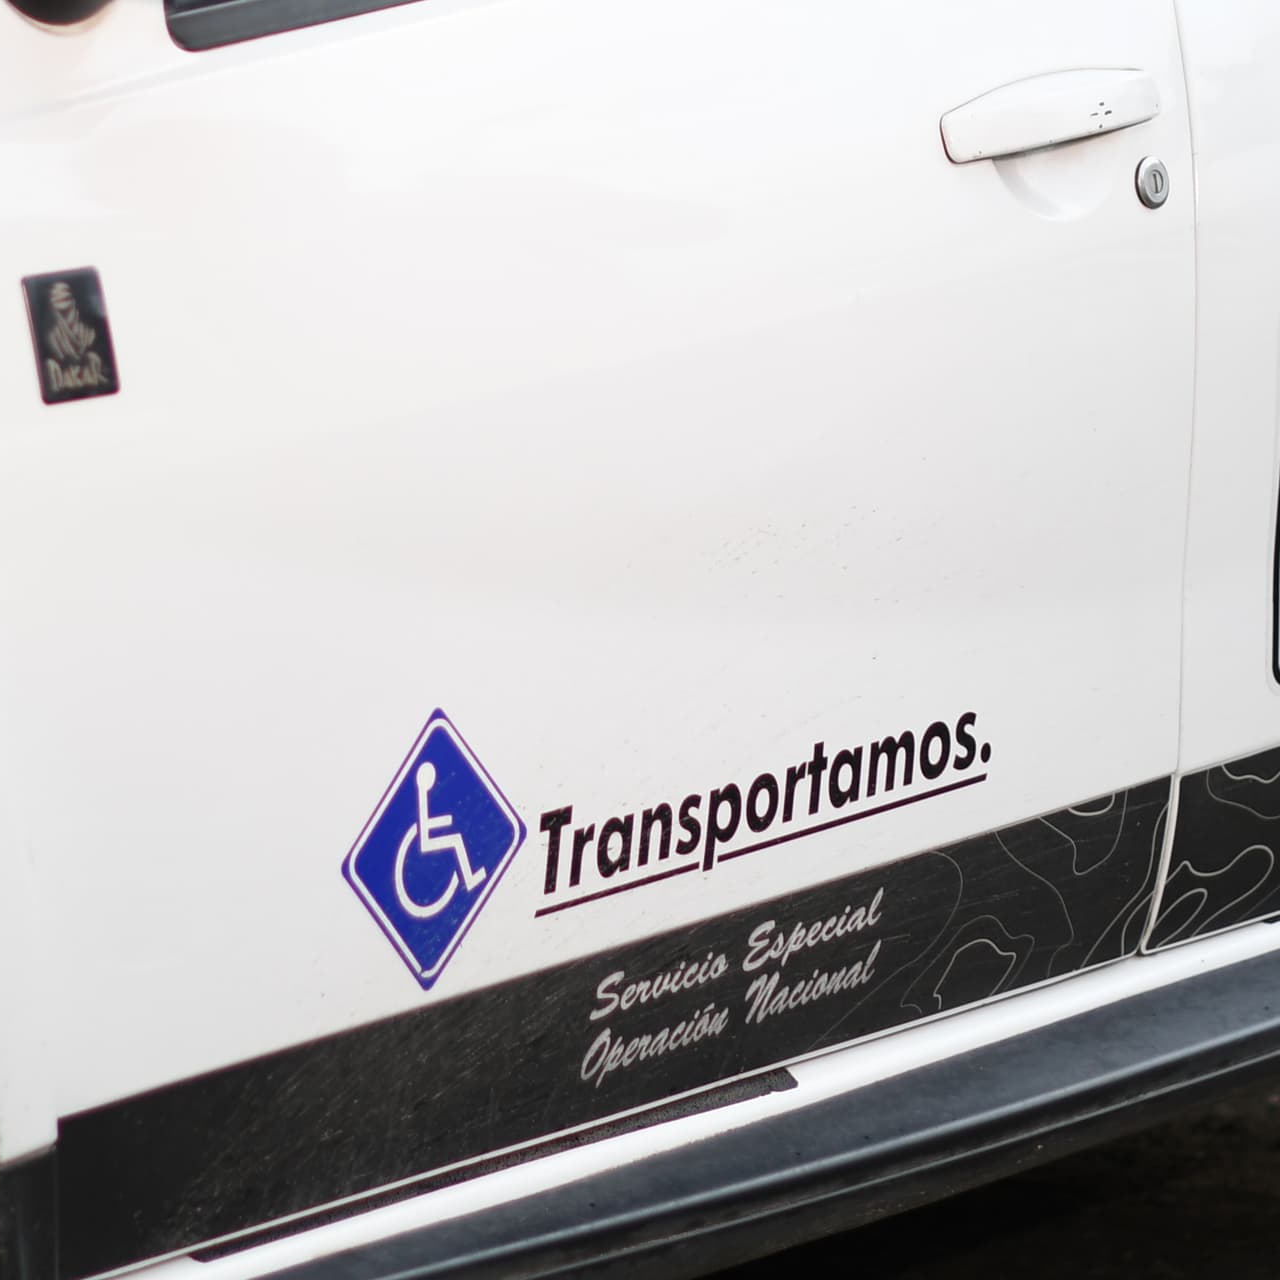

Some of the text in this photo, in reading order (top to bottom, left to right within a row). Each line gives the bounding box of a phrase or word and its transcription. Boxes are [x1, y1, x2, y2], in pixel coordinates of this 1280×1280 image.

[538, 711, 992, 873] Transportamos.
[580, 938, 882, 1089] Operación Nacional
[589, 886, 885, 1021] Servicio Especial
